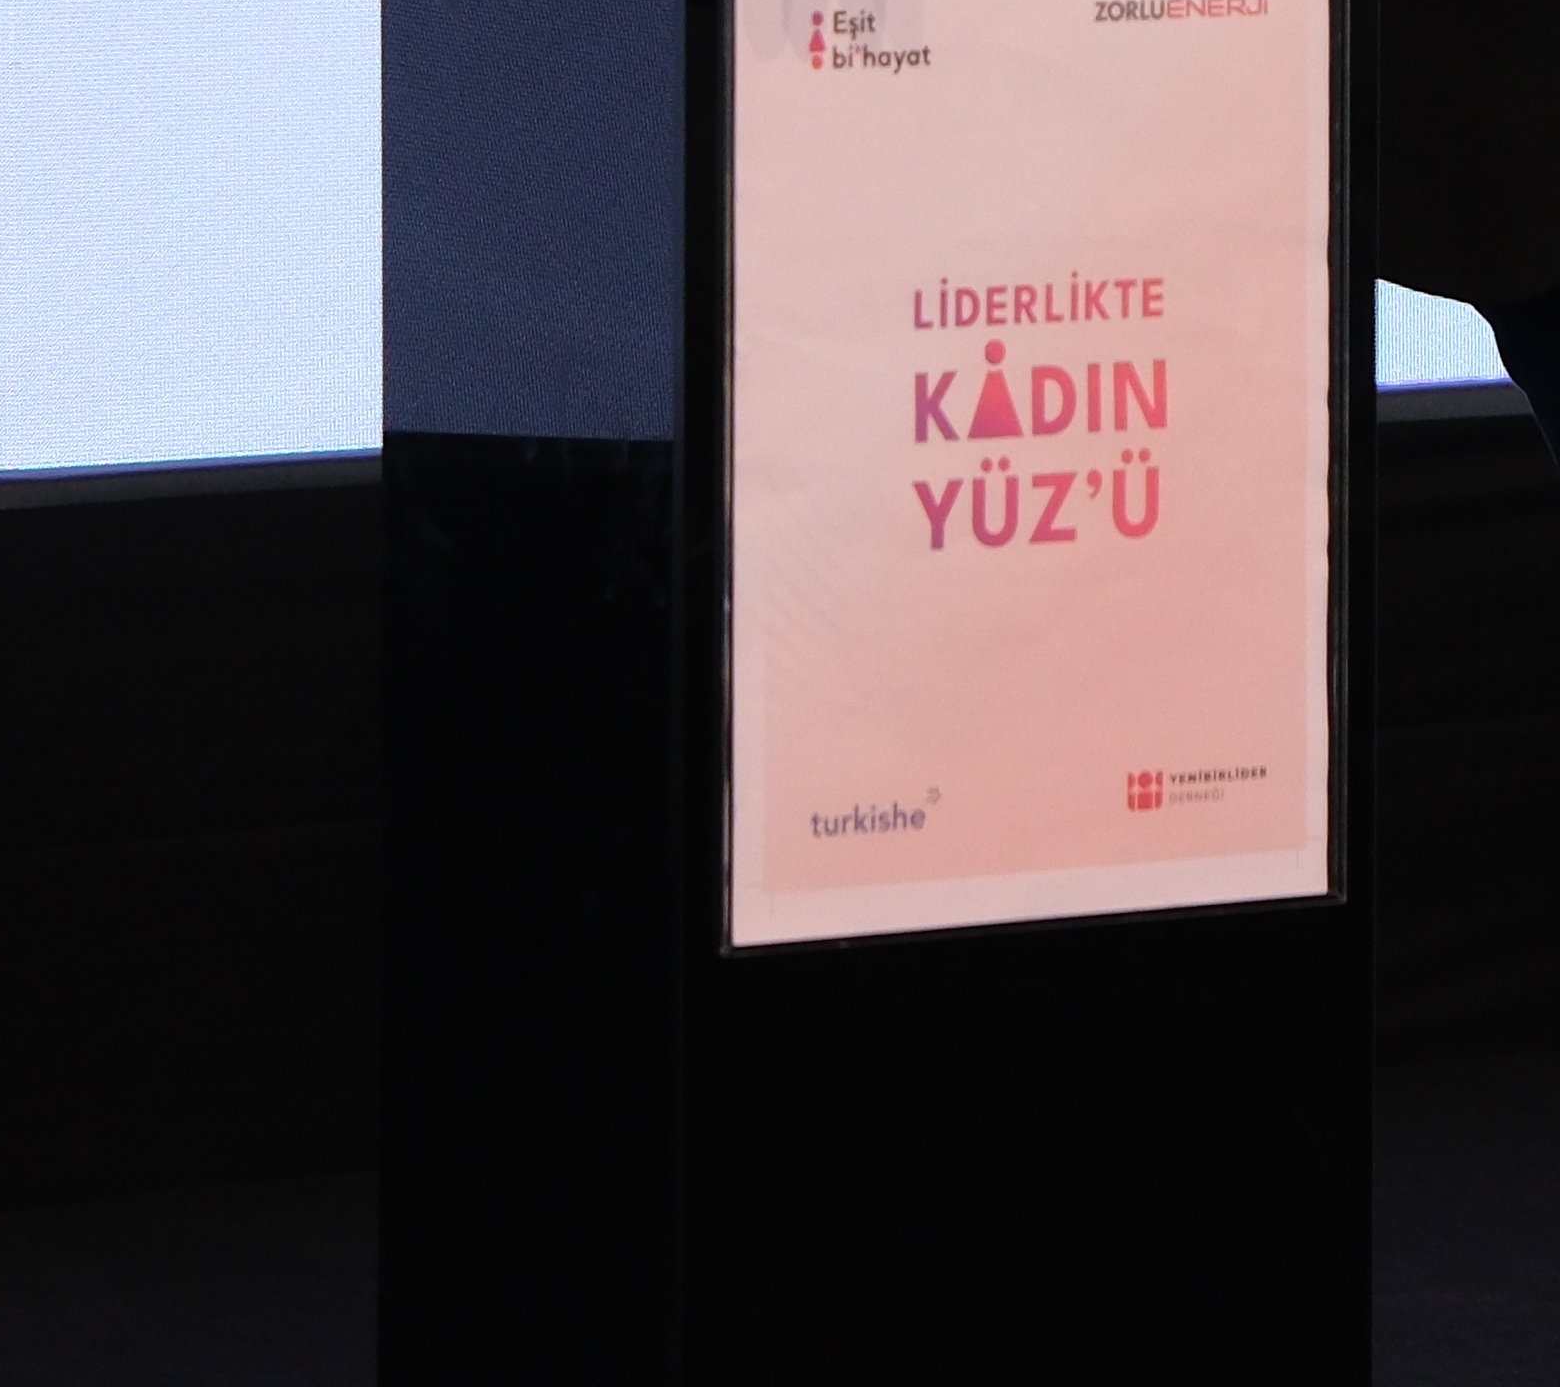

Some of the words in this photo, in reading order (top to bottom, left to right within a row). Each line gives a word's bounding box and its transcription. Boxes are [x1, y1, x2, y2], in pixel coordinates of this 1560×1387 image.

[833, 9, 876, 40] Eşit
[914, 270, 1164, 329] LİDERLİKTE
[912, 447, 1160, 550] YÜZ'Ü
